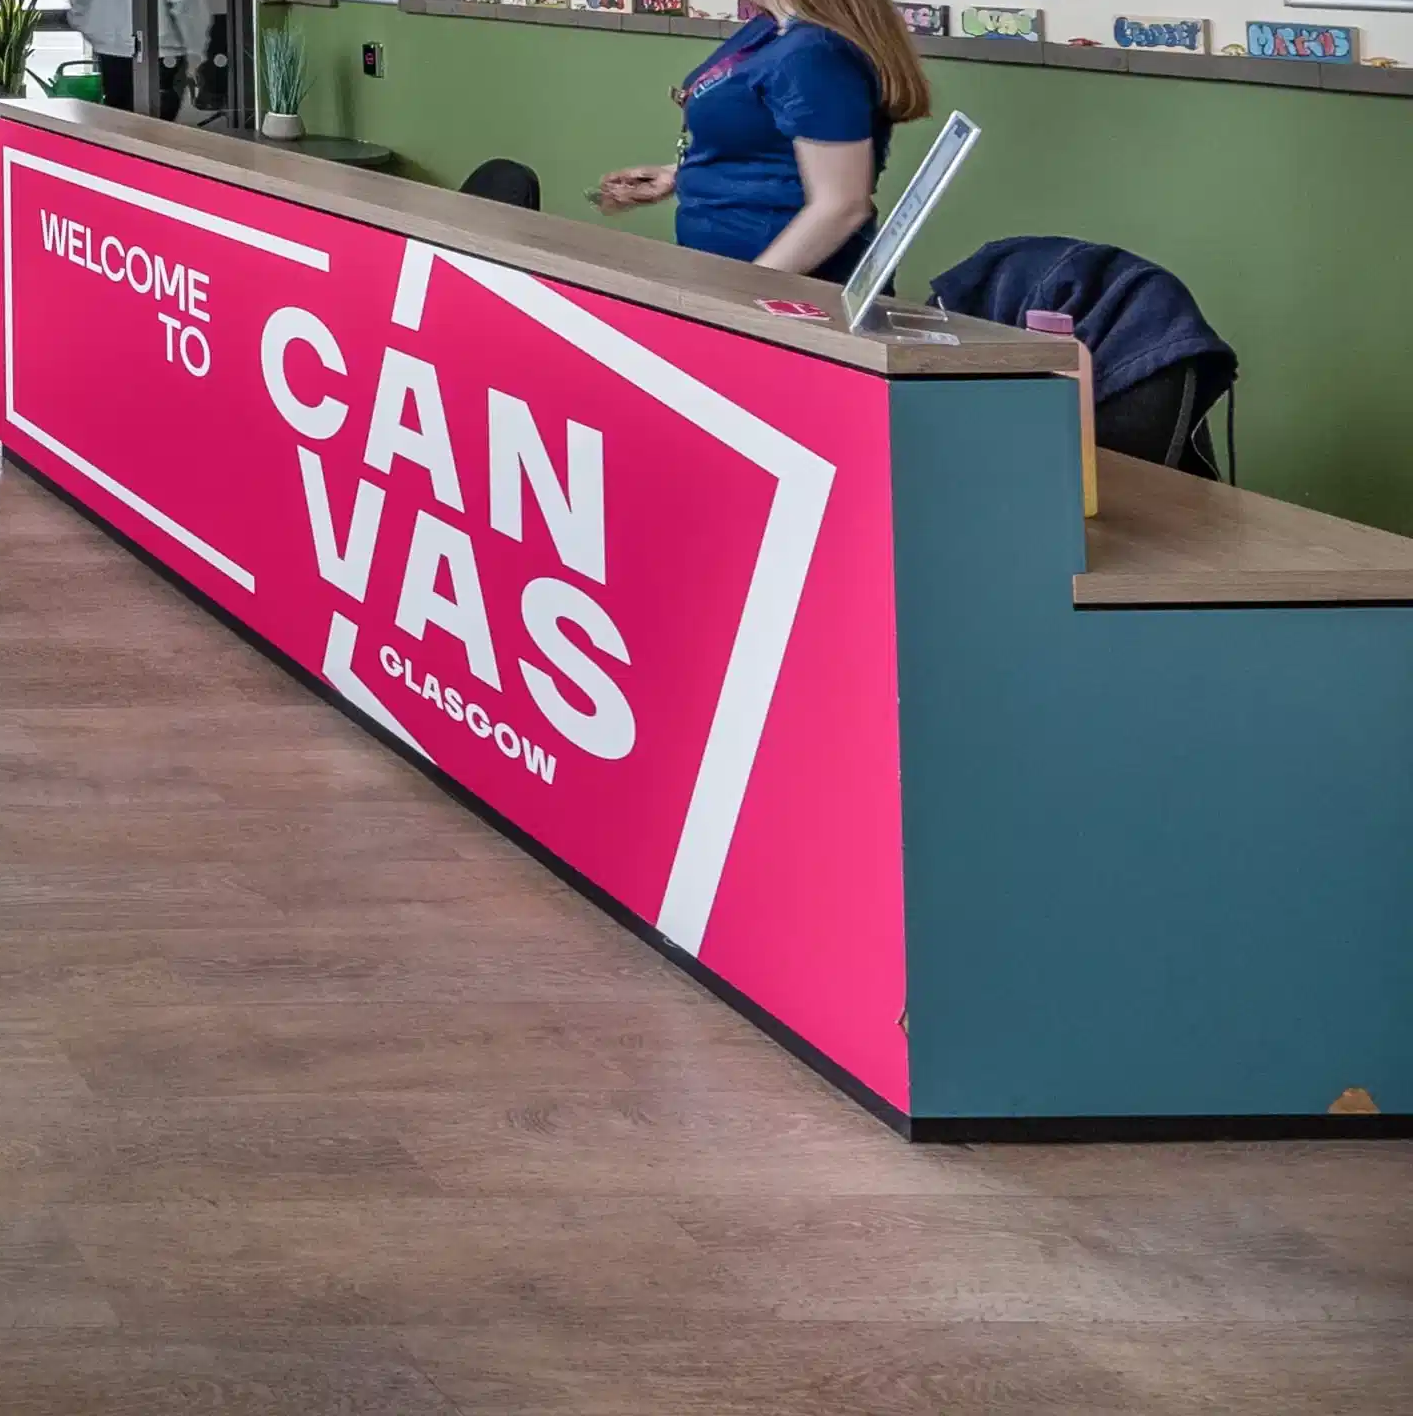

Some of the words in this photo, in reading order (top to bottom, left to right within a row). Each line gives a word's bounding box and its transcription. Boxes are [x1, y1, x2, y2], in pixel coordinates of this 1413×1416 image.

[40, 208, 211, 323] WELCOME
[157, 312, 212, 378] TO
[260, 306, 607, 586] CAN
[296, 444, 637, 761] VAS
[379, 644, 557, 785] GLASGOW
